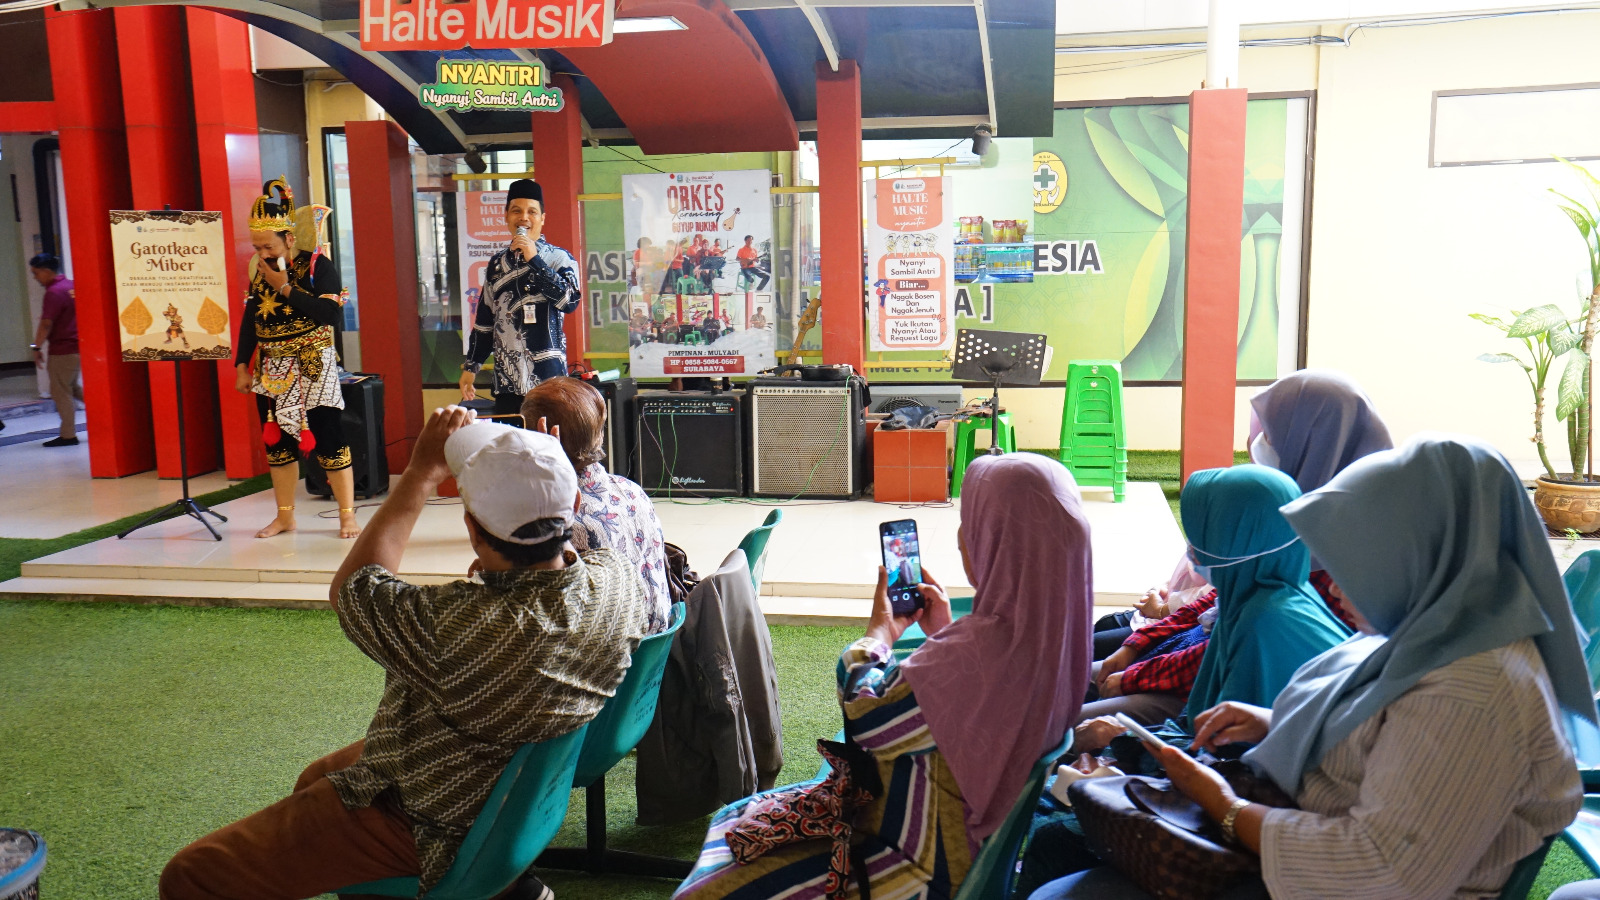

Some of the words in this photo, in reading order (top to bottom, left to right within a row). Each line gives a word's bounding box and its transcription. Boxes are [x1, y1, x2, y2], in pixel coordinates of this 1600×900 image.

[363, 0, 465, 43] Halte
[441, 63, 541, 86] NYANTRI
[423, 88, 471, 107] Nyanyi
[474, 89, 519, 106] Sambil
[521, 90, 559, 107] Antri
[667, 183, 724, 214] ORKES
[892, 193, 929, 204] HALTE
[480, 205, 505, 215] HALT
[893, 205, 928, 216] MUSIC
[130, 241, 209, 260] Gatotkaca
[146, 255, 195, 272] Miber
[899, 259, 926, 267] Nyanyi
[890, 268, 916, 276] Sambil
[899, 280, 926, 289] Biar...
[890, 293, 914, 302] Nggak
[914, 292, 935, 300] Bosen
[905, 299, 920, 307] Dan
[891, 307, 914, 316] Nggak
[914, 306, 935, 314] Jenuh
[894, 320, 909, 328] Yuk
[910, 320, 933, 328] Ikutan
[891, 327, 917, 336] Nyanyi
[918, 327, 937, 335] Atau
[890, 334, 919, 343] Request
[920, 334, 938, 342] Lagu
[683, 365, 725, 373] SURABAYA
